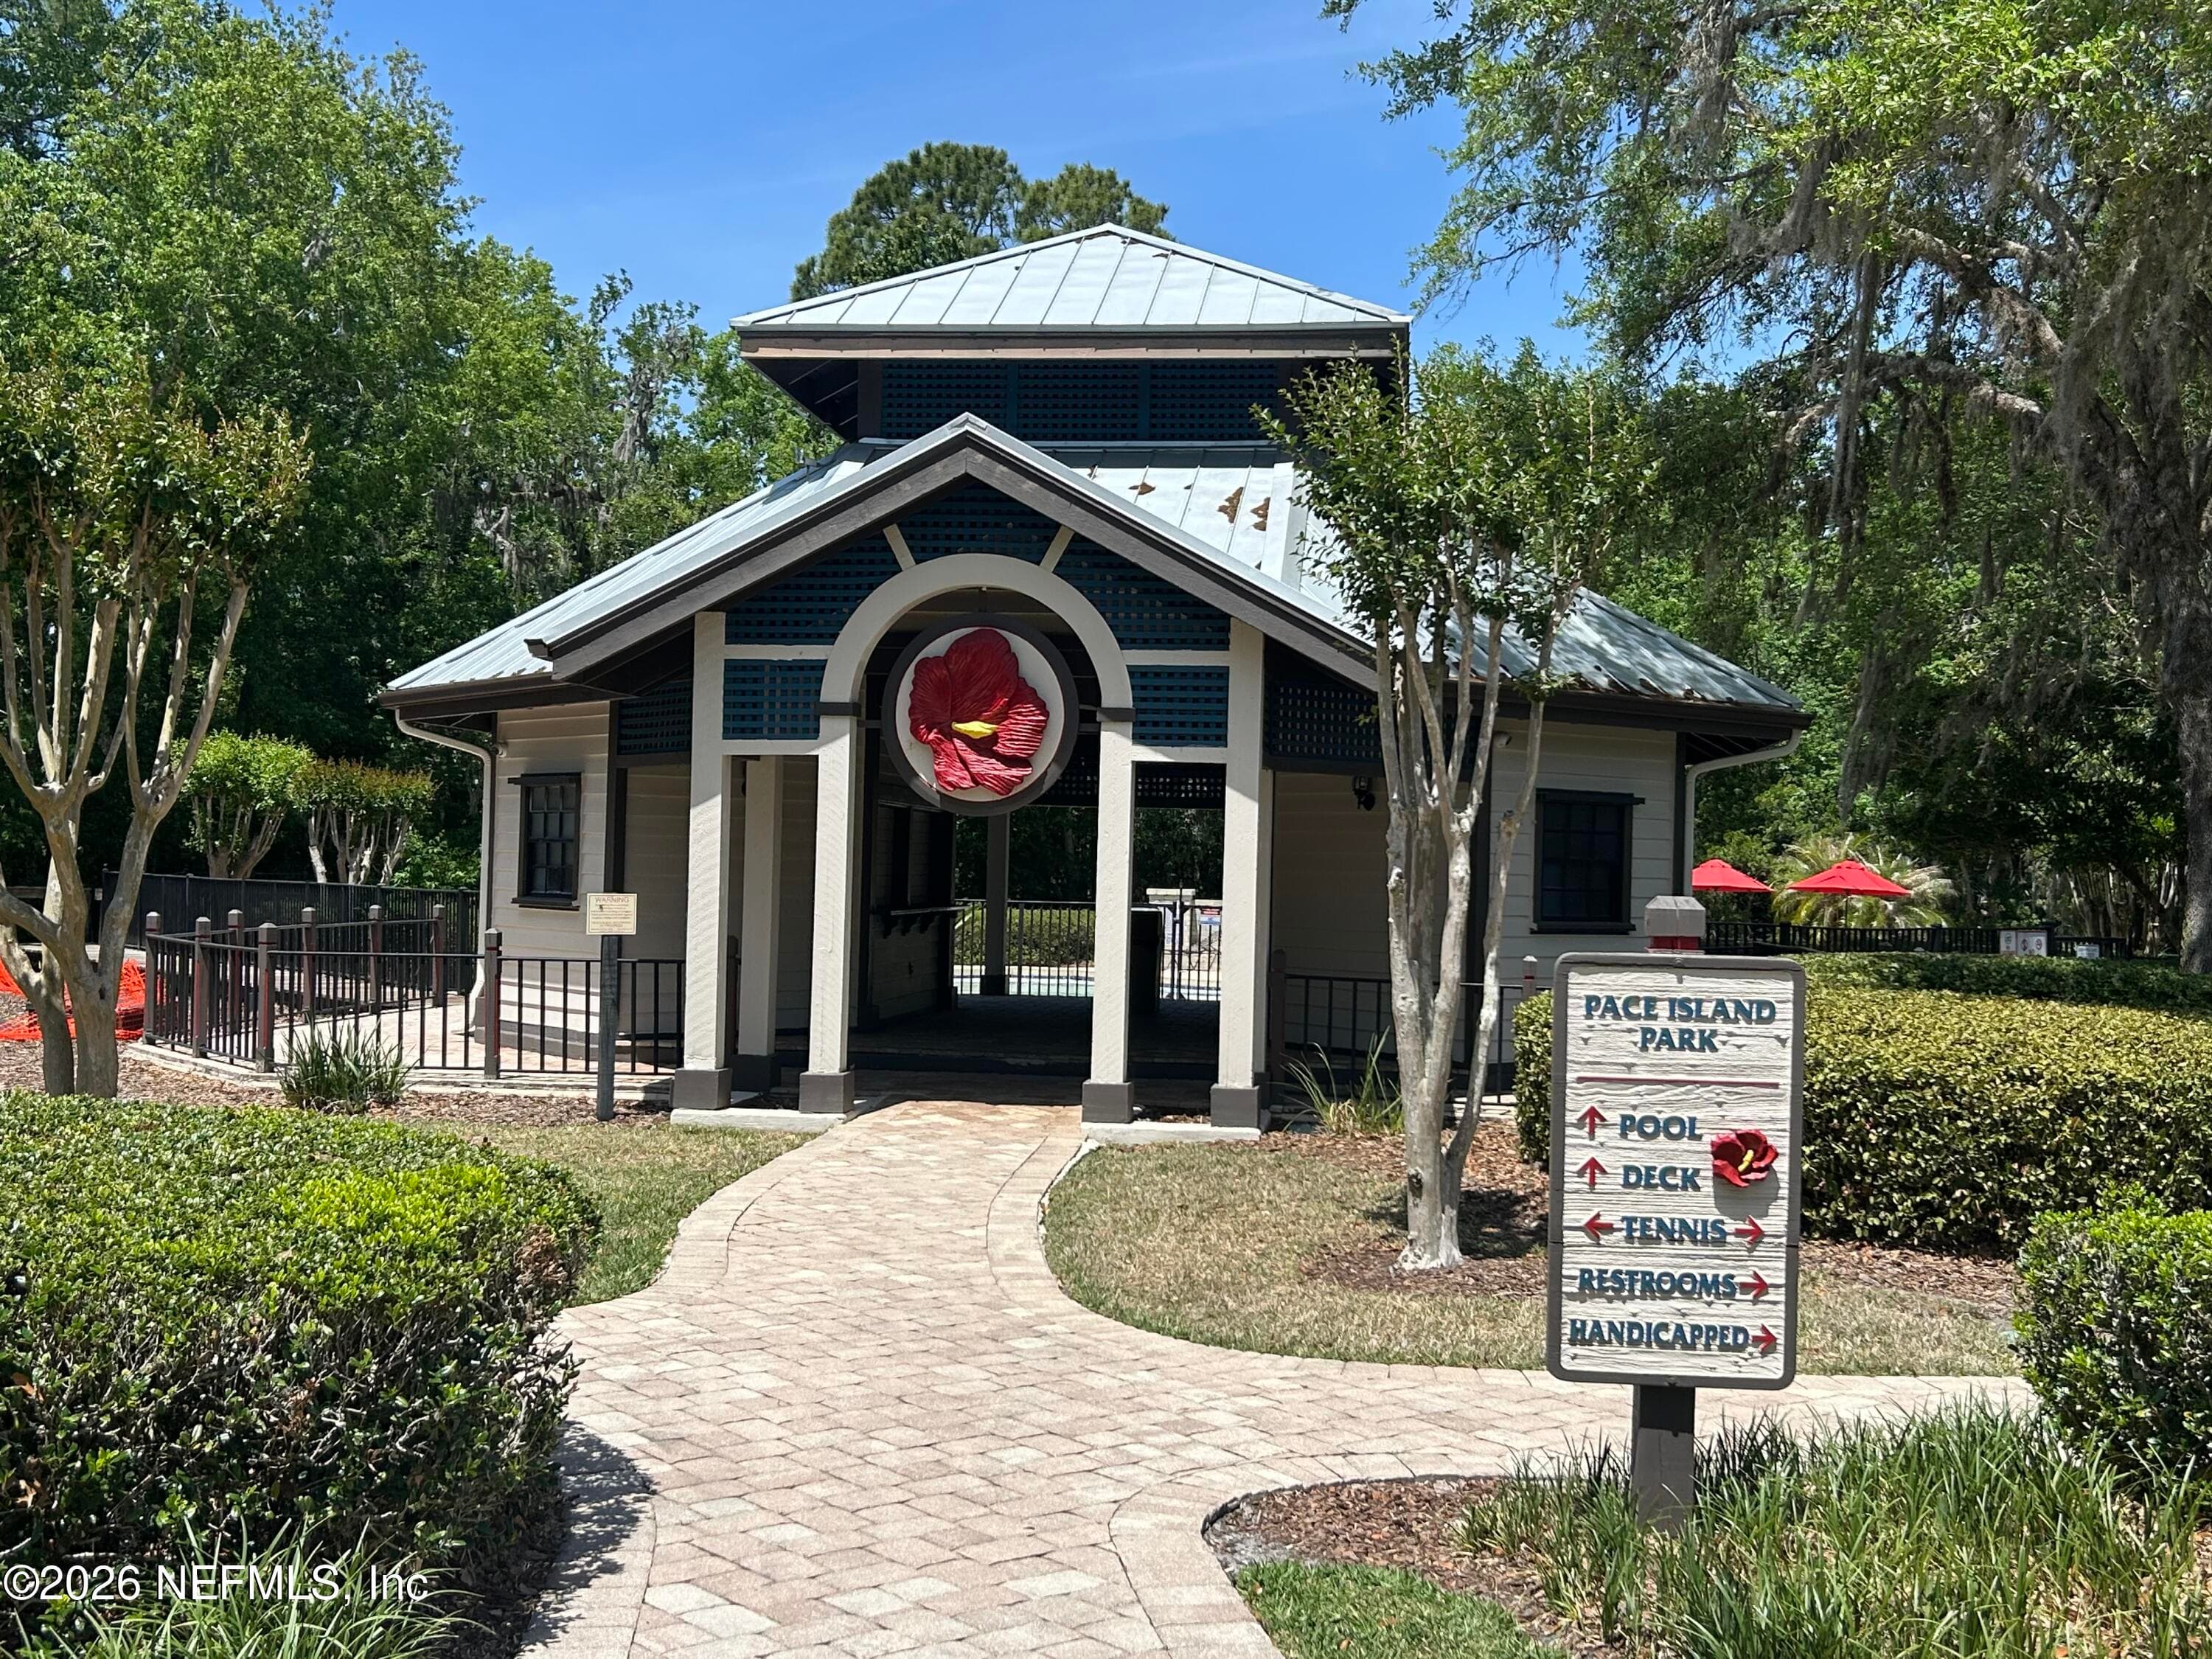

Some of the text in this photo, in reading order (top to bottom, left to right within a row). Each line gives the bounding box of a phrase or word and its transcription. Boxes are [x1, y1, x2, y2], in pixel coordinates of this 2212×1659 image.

[1585, 995, 1776, 1025] PACE ISLAND
[1639, 1026, 1719, 1053] PARK
[1619, 1113, 1703, 1141] POOL
[1621, 1165, 1701, 1192] DECK
[1621, 1216, 1728, 1242] TENNIS
[1579, 1267, 1736, 1298] RESTROOMS
[1569, 1318, 1750, 1351] HANDICAPPED
